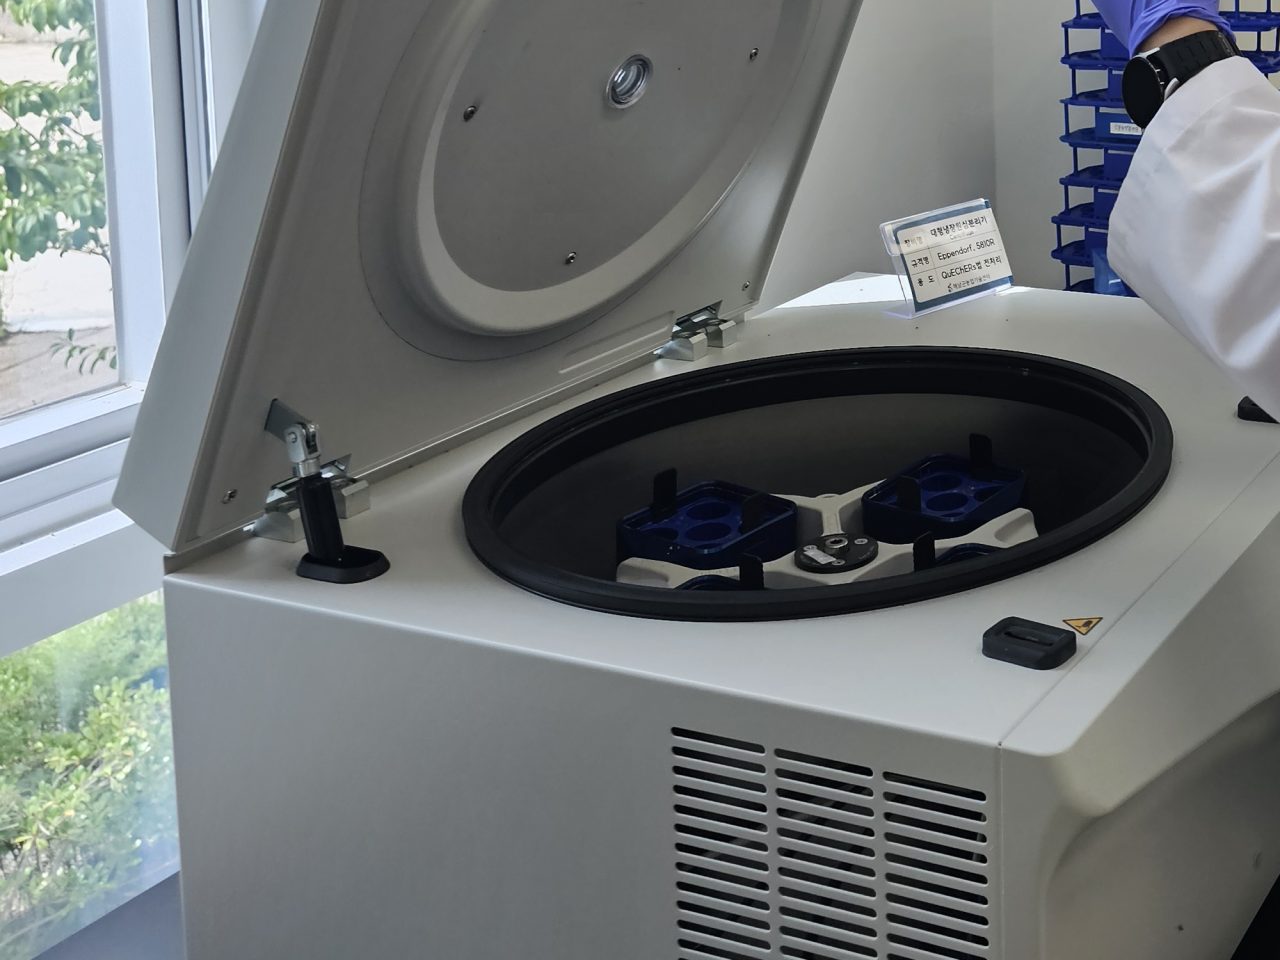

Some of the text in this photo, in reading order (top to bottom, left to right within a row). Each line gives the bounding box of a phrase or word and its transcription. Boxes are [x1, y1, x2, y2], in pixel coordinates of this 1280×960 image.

[976, 238, 996, 251] 5810R
[911, 256, 930, 269] 규격명
[983, 255, 1003, 268] 전처리
